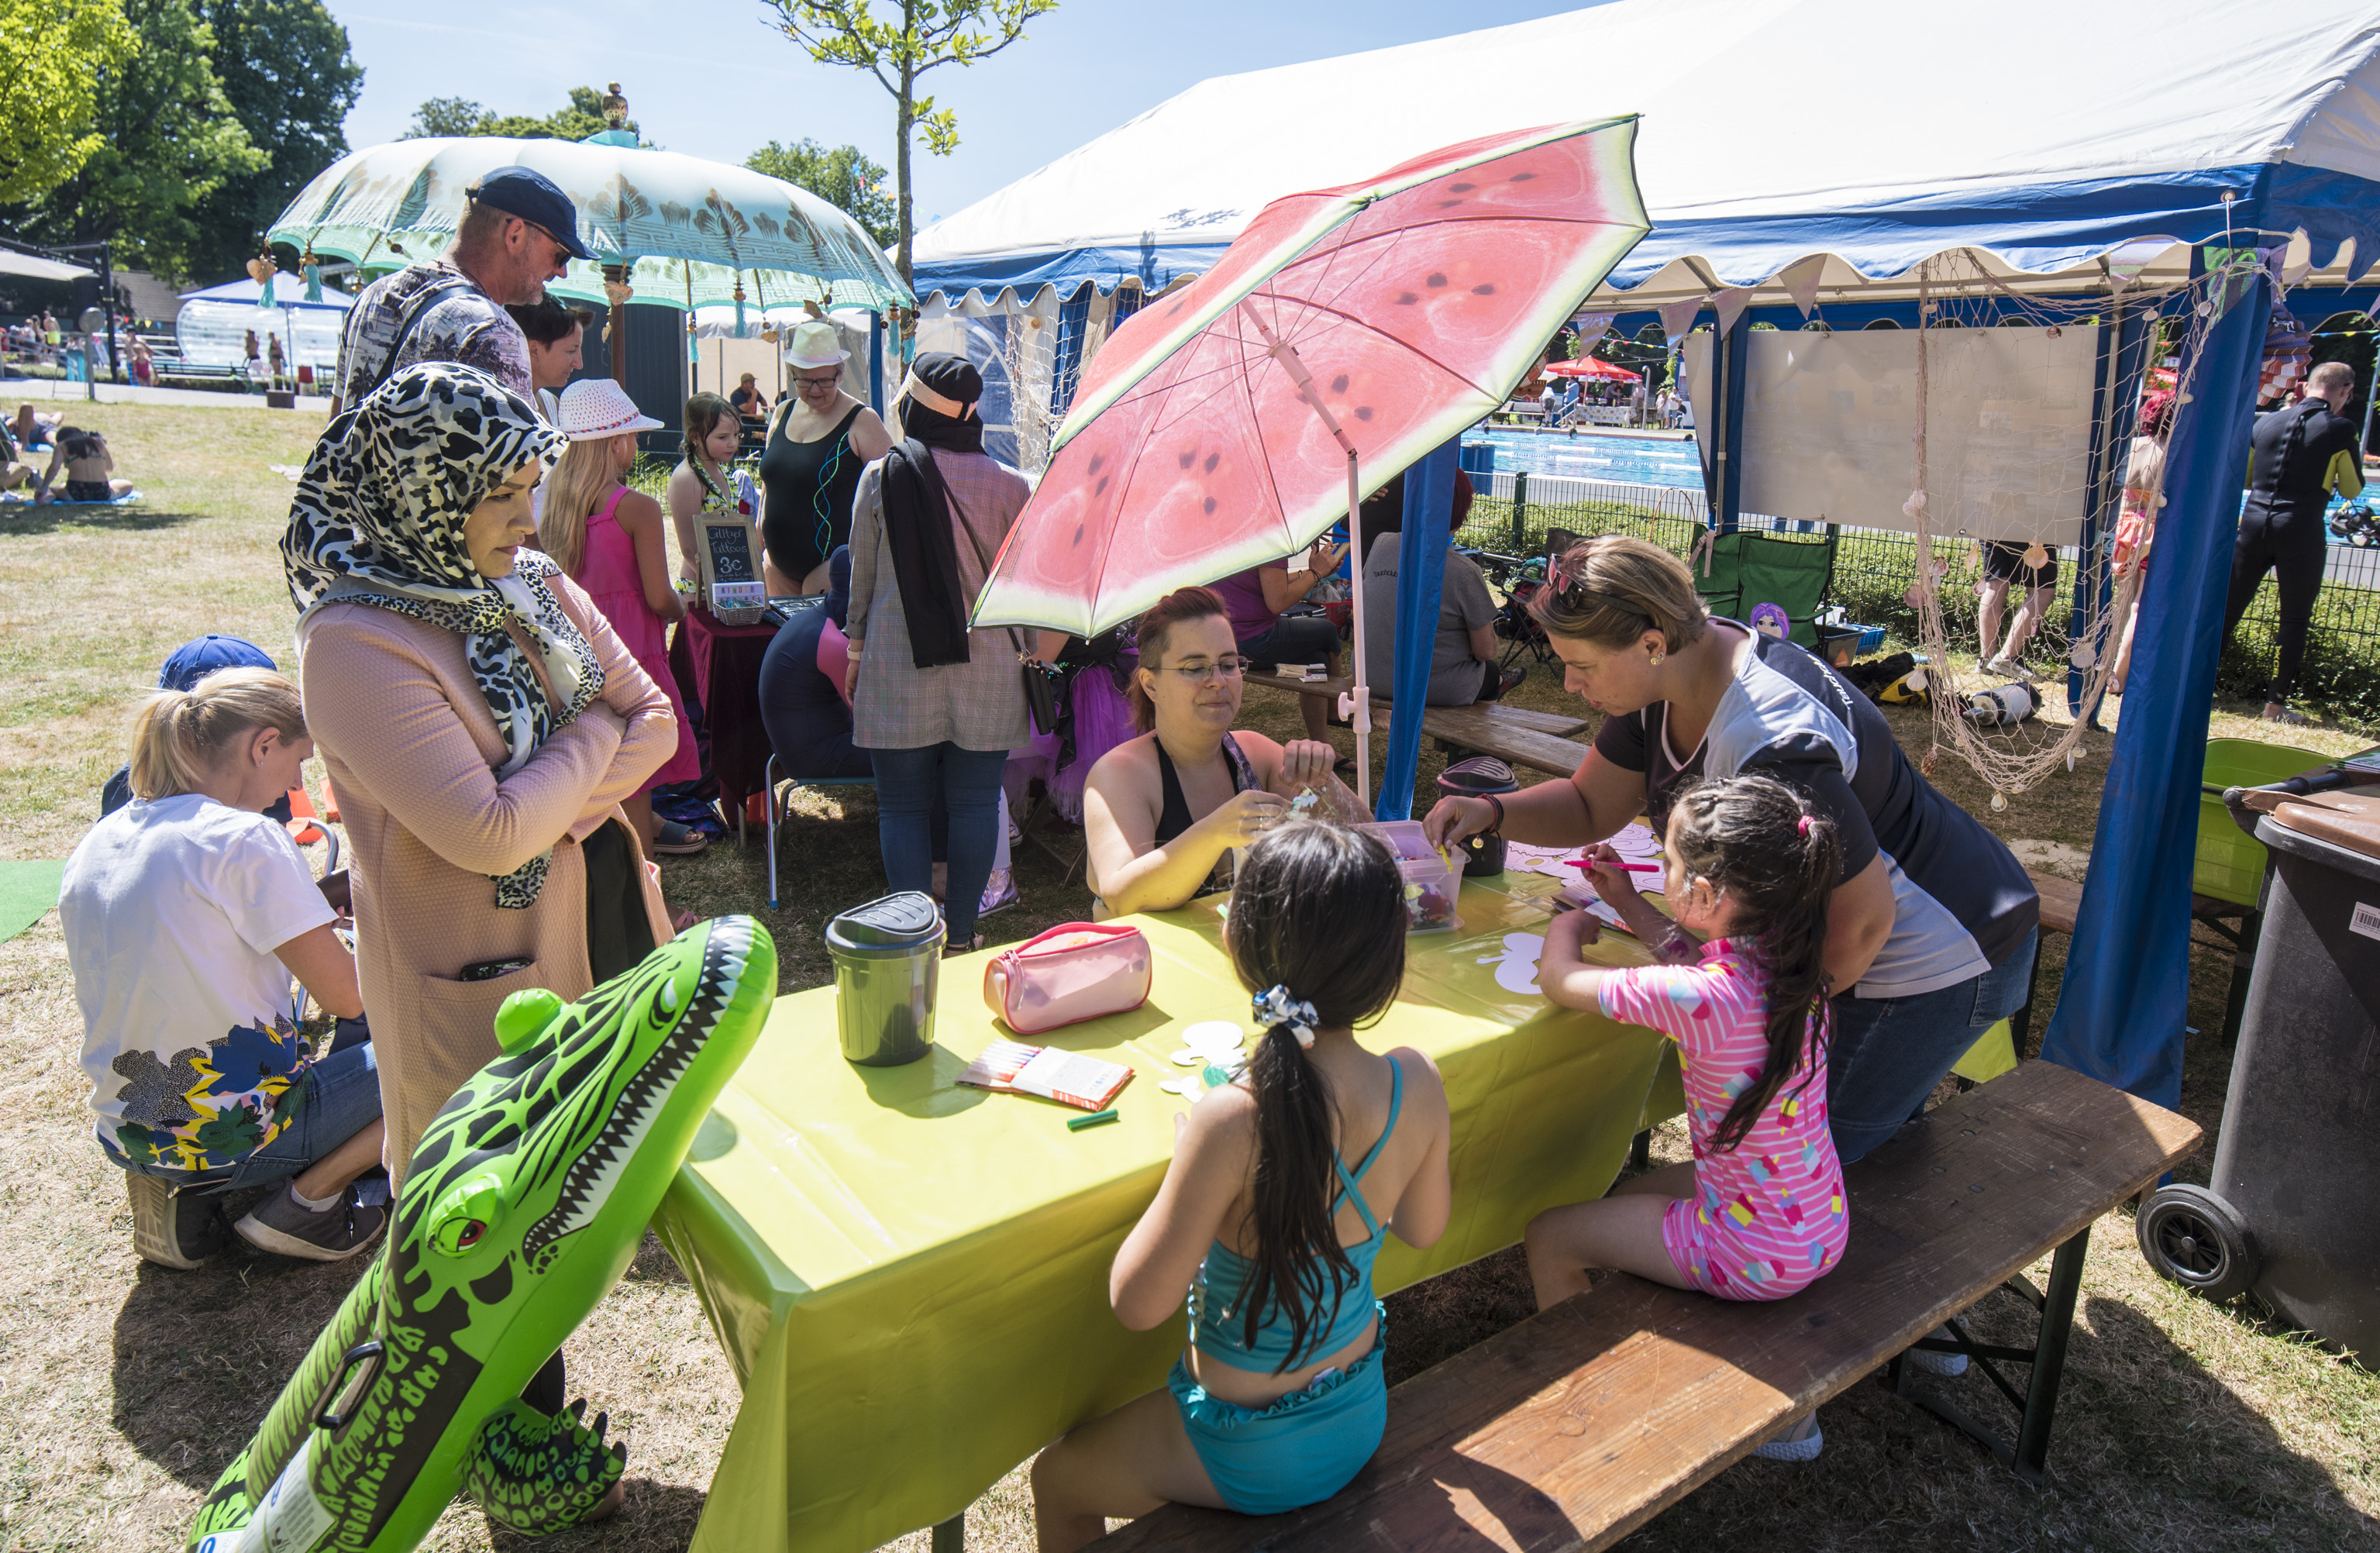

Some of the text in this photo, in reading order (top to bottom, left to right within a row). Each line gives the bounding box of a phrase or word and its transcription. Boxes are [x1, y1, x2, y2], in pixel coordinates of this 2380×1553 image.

[708, 527, 743, 544] Glitzer
[711, 542, 748, 553] Tattoos
[720, 556, 742, 573] 3€
[722, 585, 754, 594] KINDER
